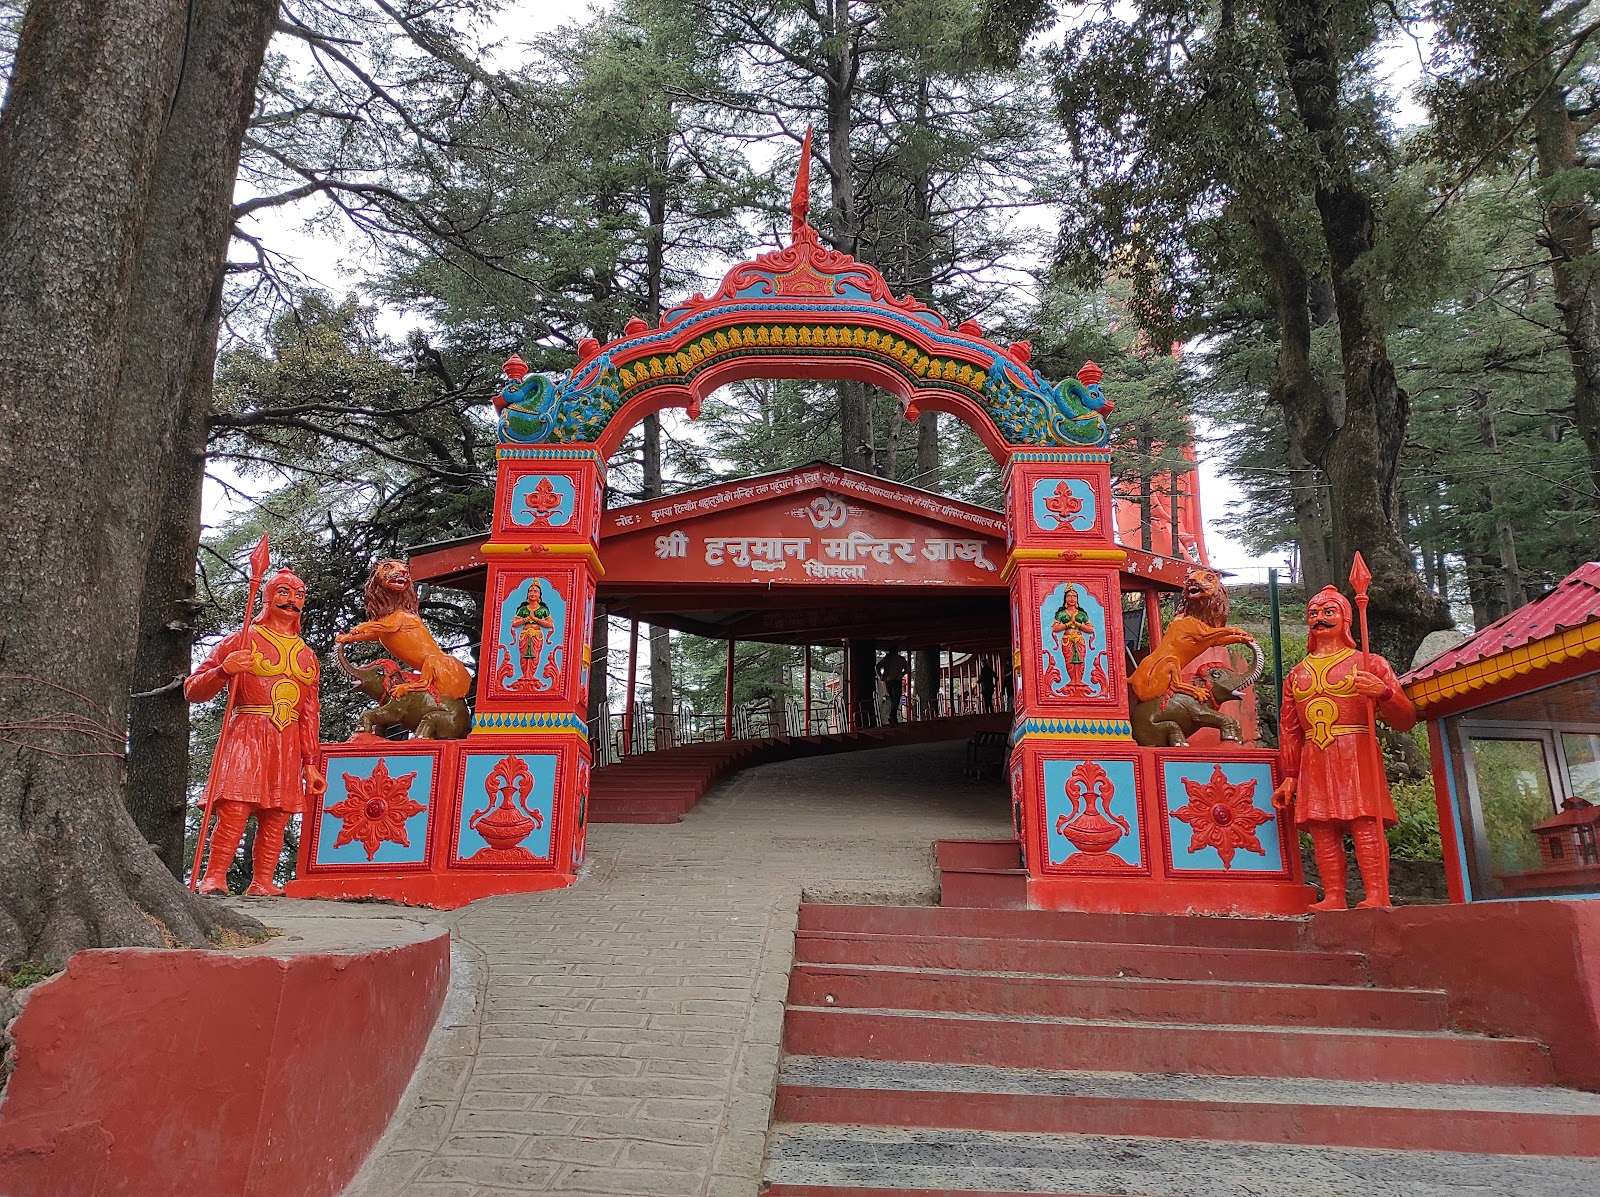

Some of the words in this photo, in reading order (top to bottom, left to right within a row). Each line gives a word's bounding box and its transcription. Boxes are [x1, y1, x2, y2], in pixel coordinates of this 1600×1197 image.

[651, 506, 673, 522] कृपया
[755, 484, 769, 495] तक
[803, 472, 820, 484] लिए
[654, 530, 690, 560] श्री
[703, 537, 811, 567] हनुमान
[820, 530, 916, 565] मन्दिर
[921, 538, 998, 572] जाखू
[802, 558, 867, 579] शिमला
